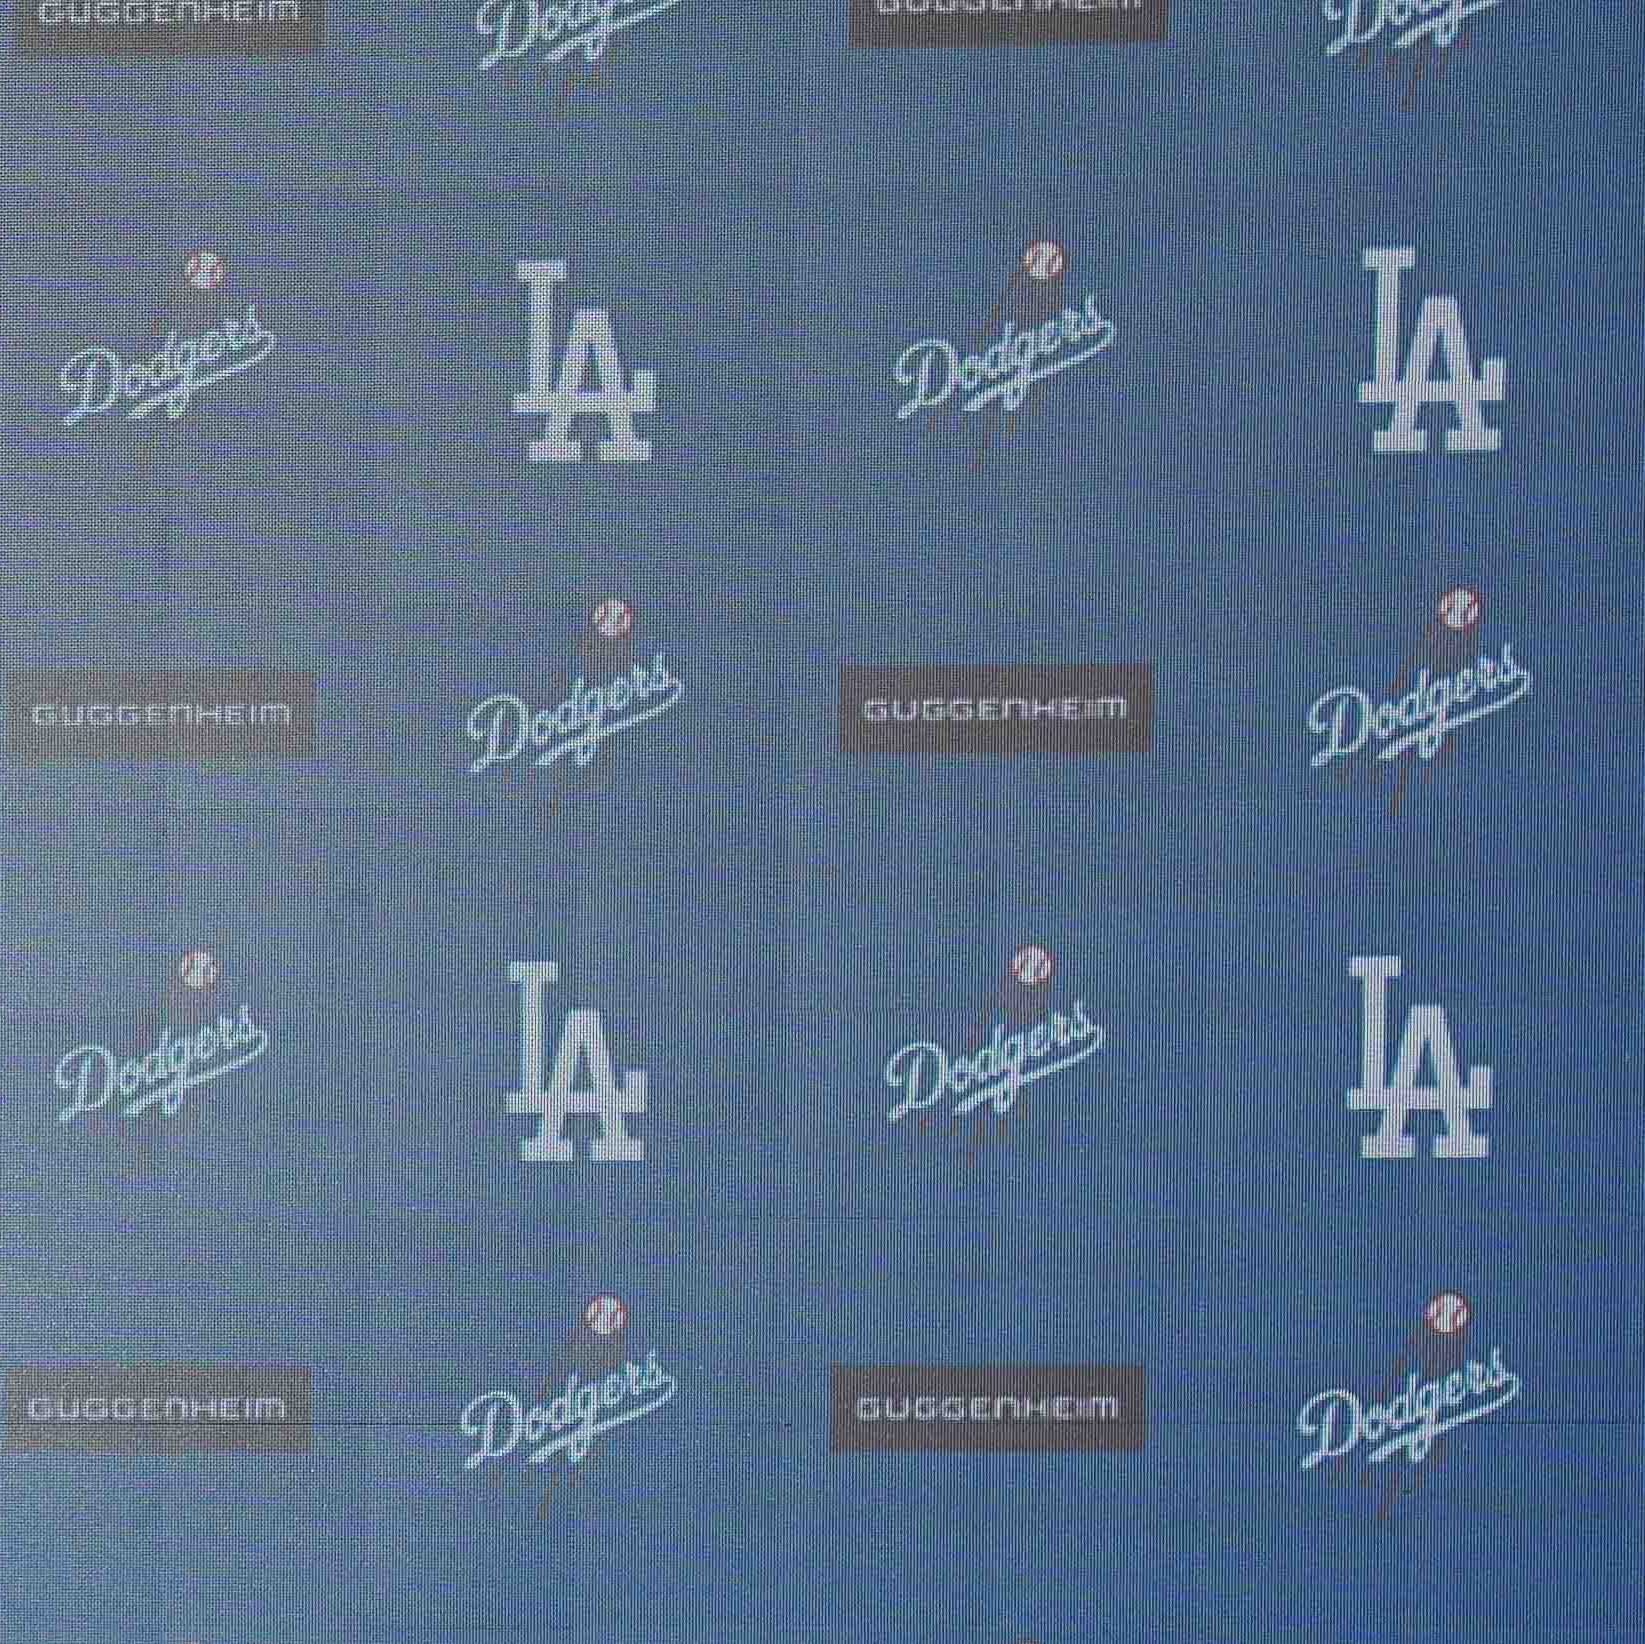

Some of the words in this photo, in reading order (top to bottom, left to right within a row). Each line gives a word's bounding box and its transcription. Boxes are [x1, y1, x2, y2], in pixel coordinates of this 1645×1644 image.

[60, 305, 275, 424] Dodgers
[513, 260, 656, 462] LA
[894, 294, 1116, 419] Dodgers
[1358, 246, 1507, 453] LA
[32, 703, 291, 726] GUGGENHEIM
[467, 654, 683, 772] Dodgers
[863, 695, 1129, 722] GUGGENHEIM
[1307, 642, 1532, 767] Dodgers
[55, 1004, 268, 1121] Dodgers
[506, 961, 647, 1162] LA
[885, 1000, 1105, 1121] Dodgers
[1346, 955, 1494, 1160] LA
[27, 1396, 288, 1420] GUGGENHEIM
[459, 1351, 676, 1469] Dodgers
[855, 1394, 1120, 1421] GUGGENHEIM
[1297, 1346, 1521, 1470] Dodgers
